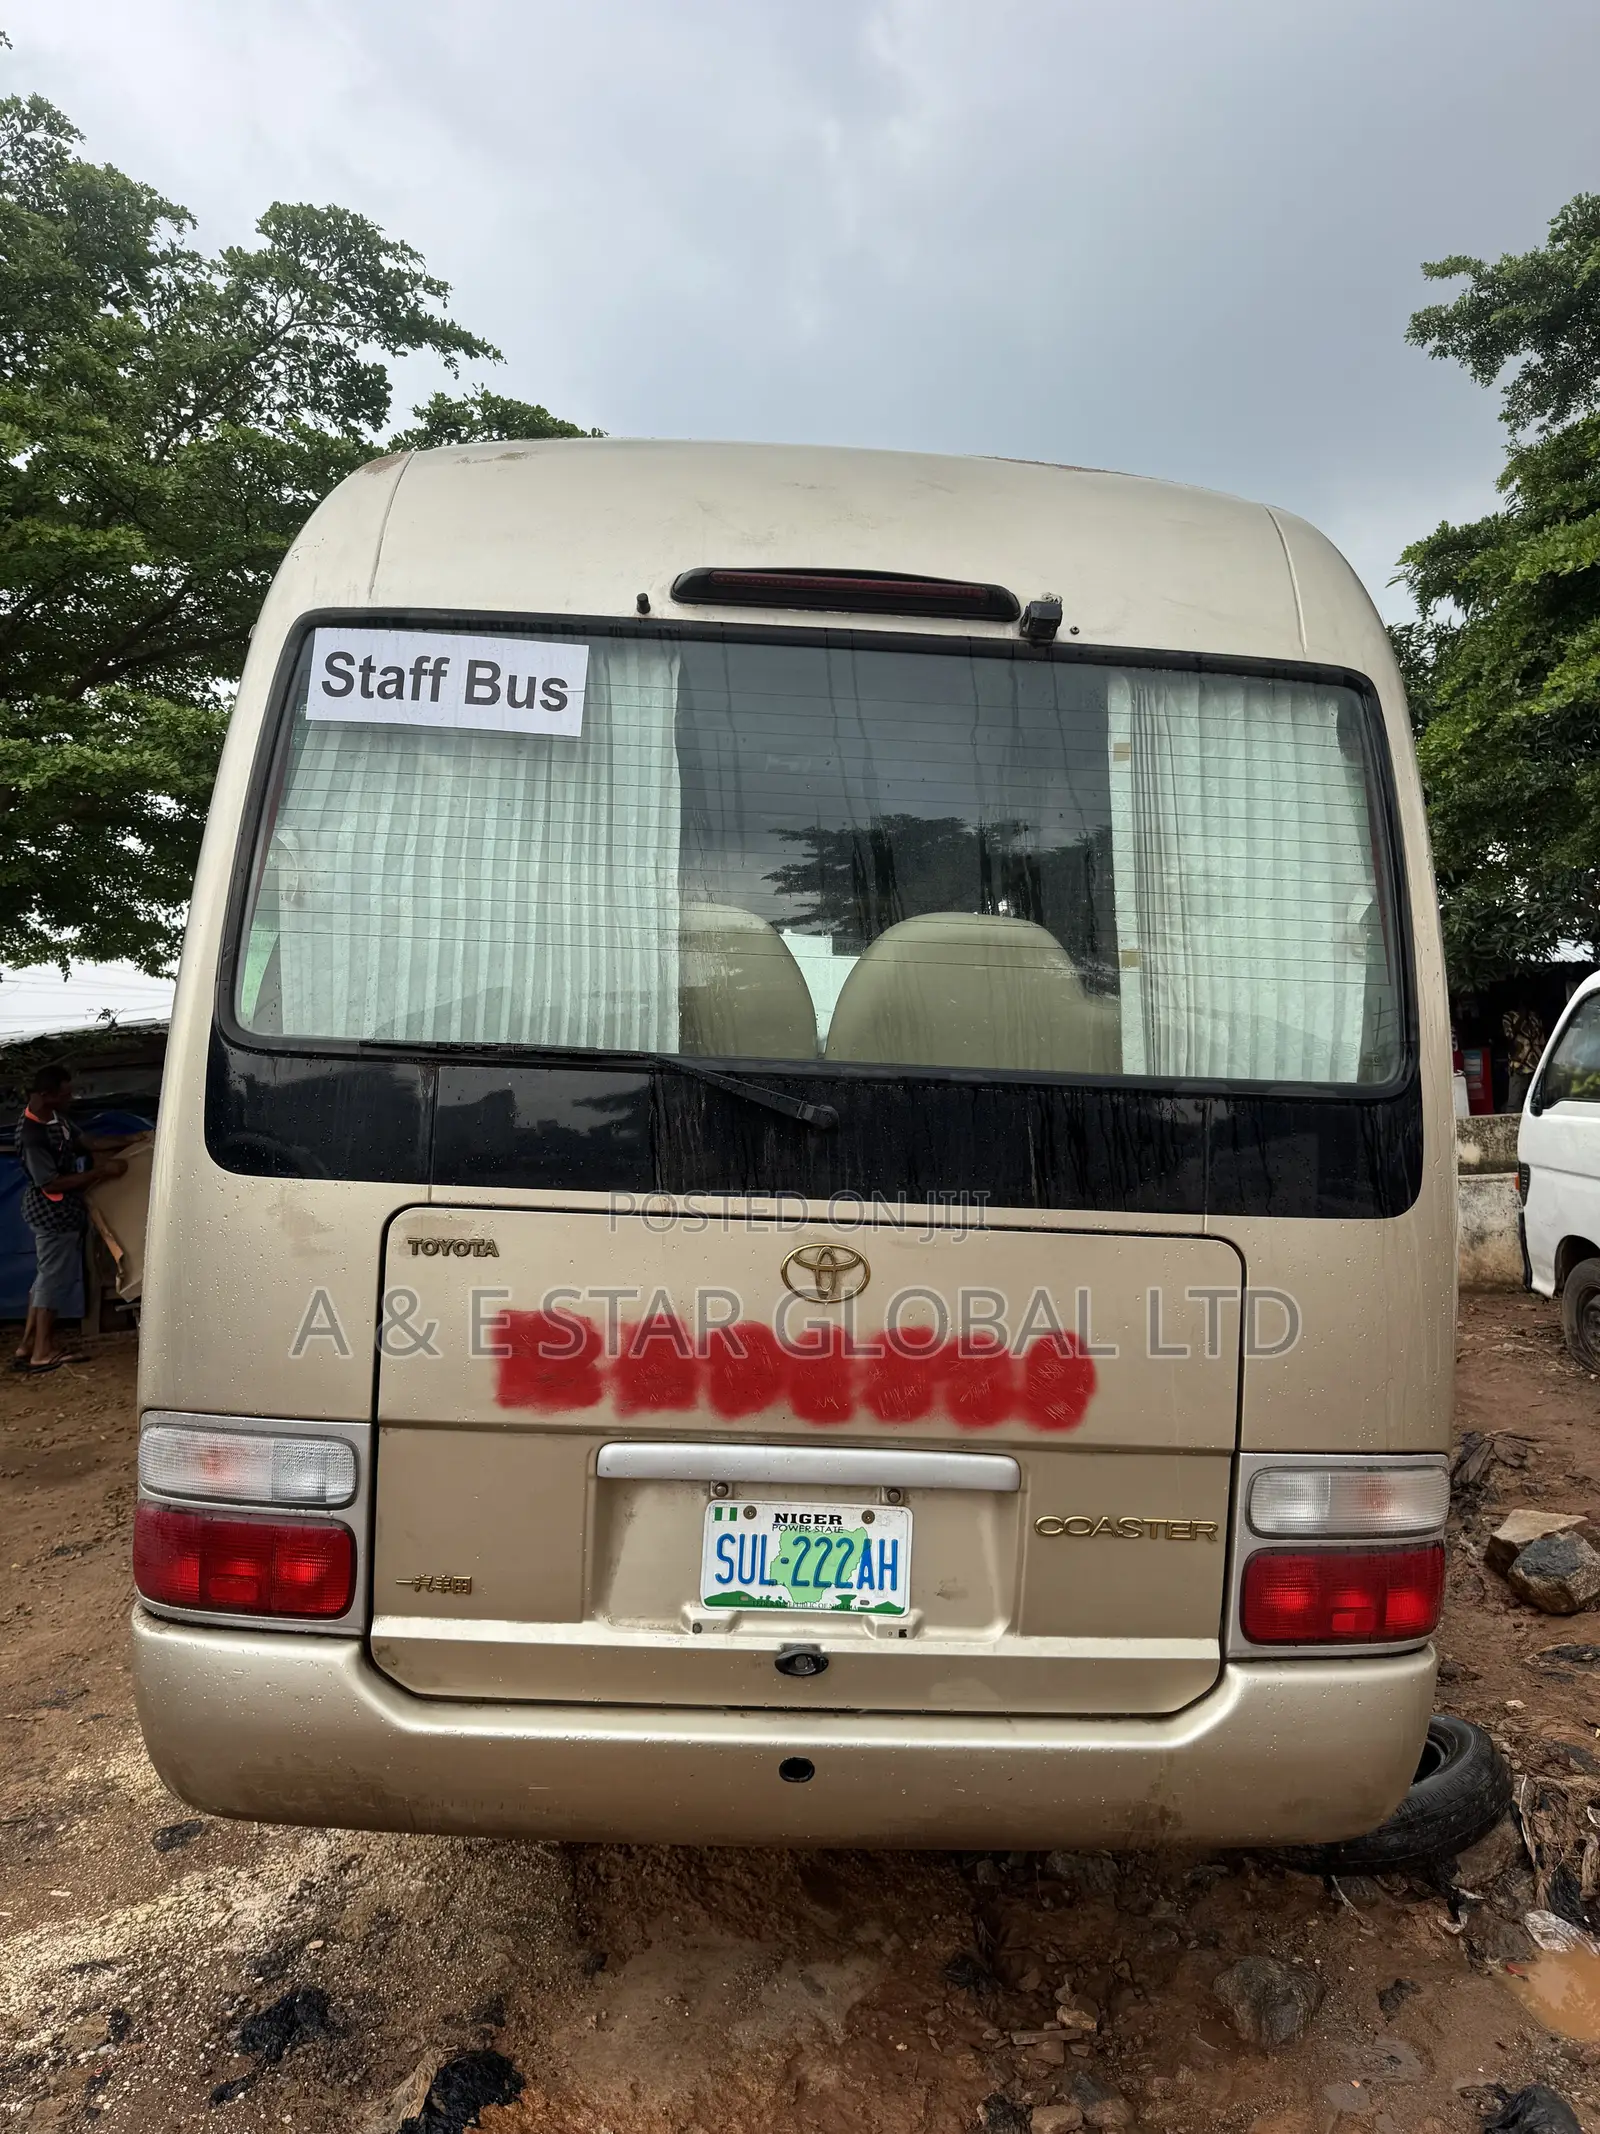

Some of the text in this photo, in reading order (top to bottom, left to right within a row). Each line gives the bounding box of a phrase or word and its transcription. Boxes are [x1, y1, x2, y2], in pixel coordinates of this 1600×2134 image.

[321, 651, 569, 711] Staff Bus
[407, 1237, 500, 1258] TOYOTA
[772, 1523, 844, 1534] POWER STATE
[774, 1513, 843, 1526] NIGER
[1034, 1515, 1219, 1542] COASTER
[714, 1533, 898, 1591] SUL-222AH
